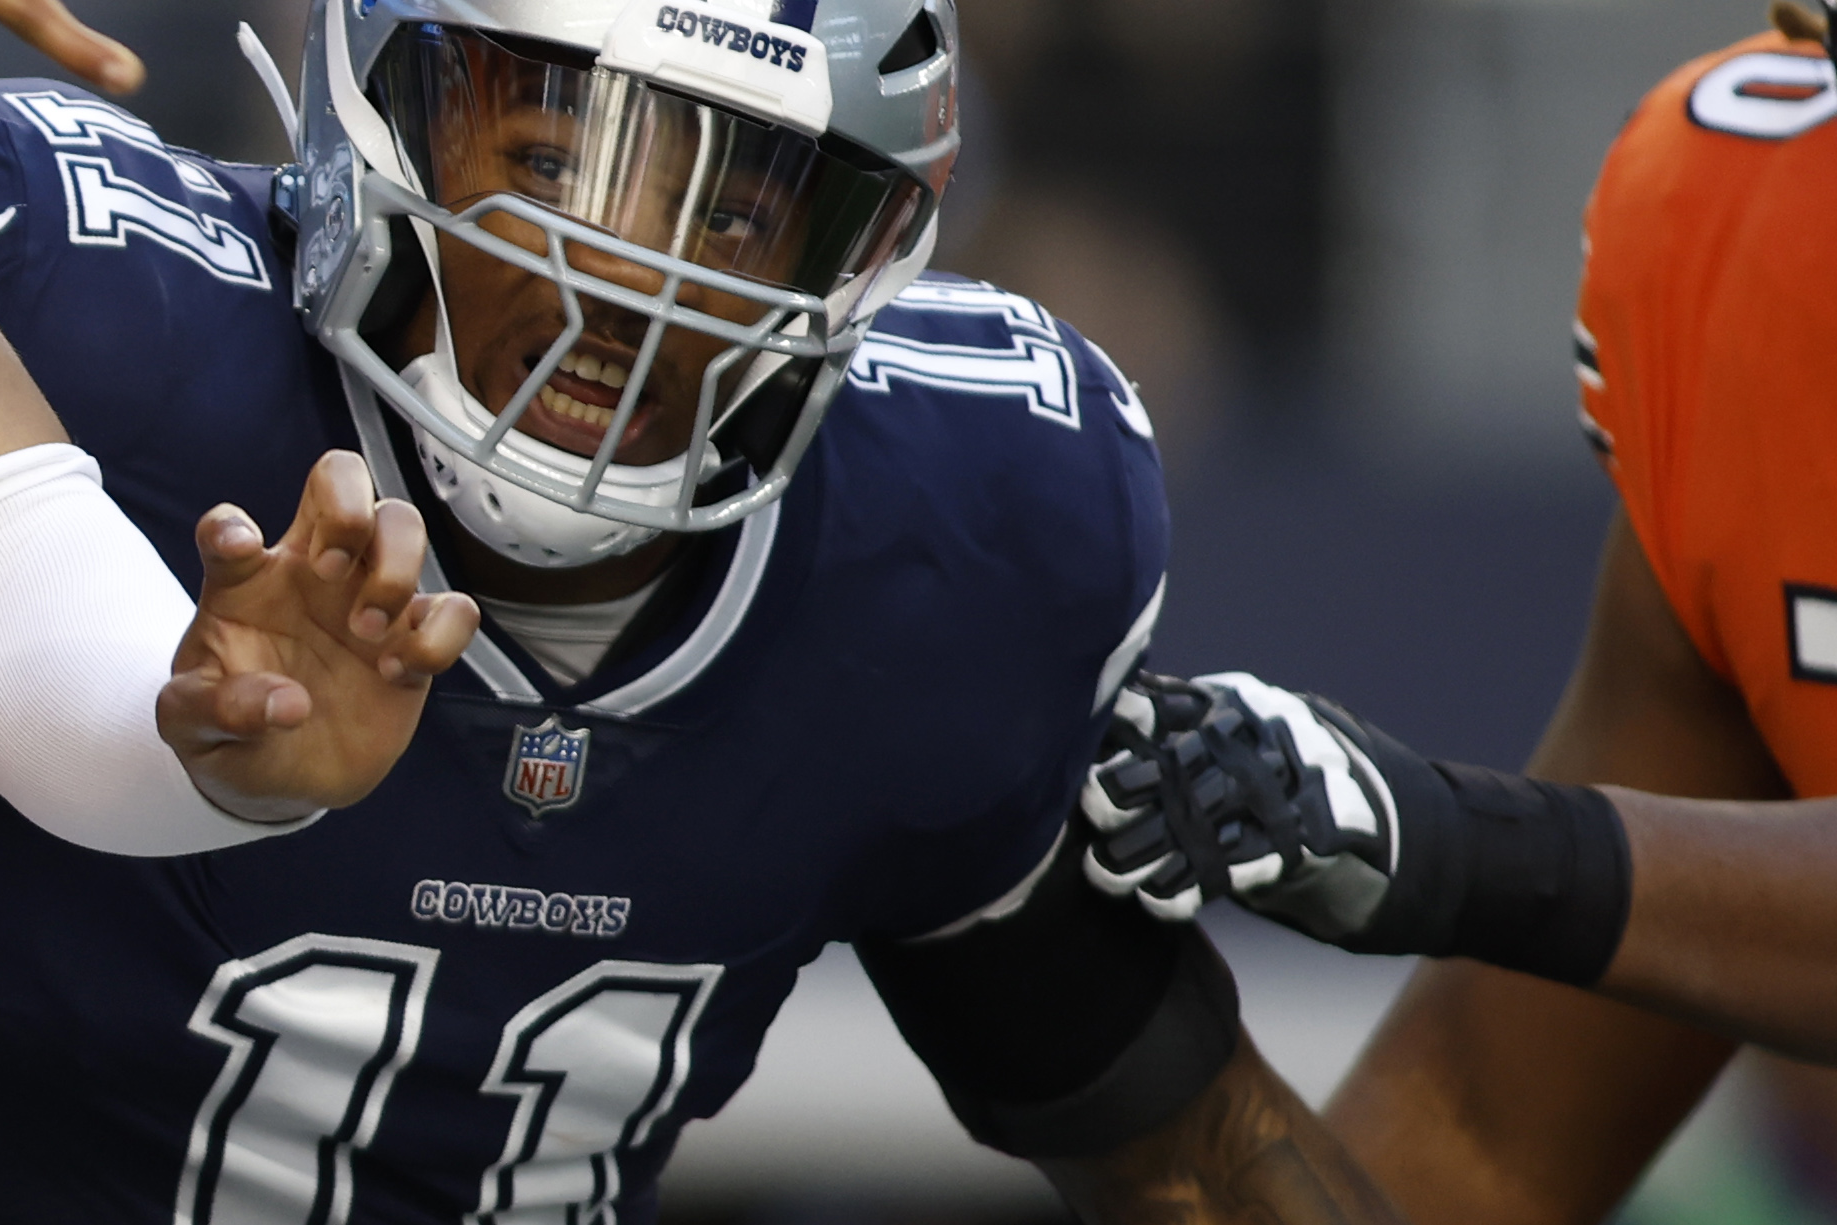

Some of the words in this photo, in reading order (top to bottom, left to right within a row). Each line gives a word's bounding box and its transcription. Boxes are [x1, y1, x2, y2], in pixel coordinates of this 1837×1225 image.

[656, 5, 807, 73] COWBOYS
[2, 90, 272, 290] 11
[516, 761, 570, 800] NFL
[411, 879, 632, 937] COWBOYS
[171, 932, 725, 1225] 11
